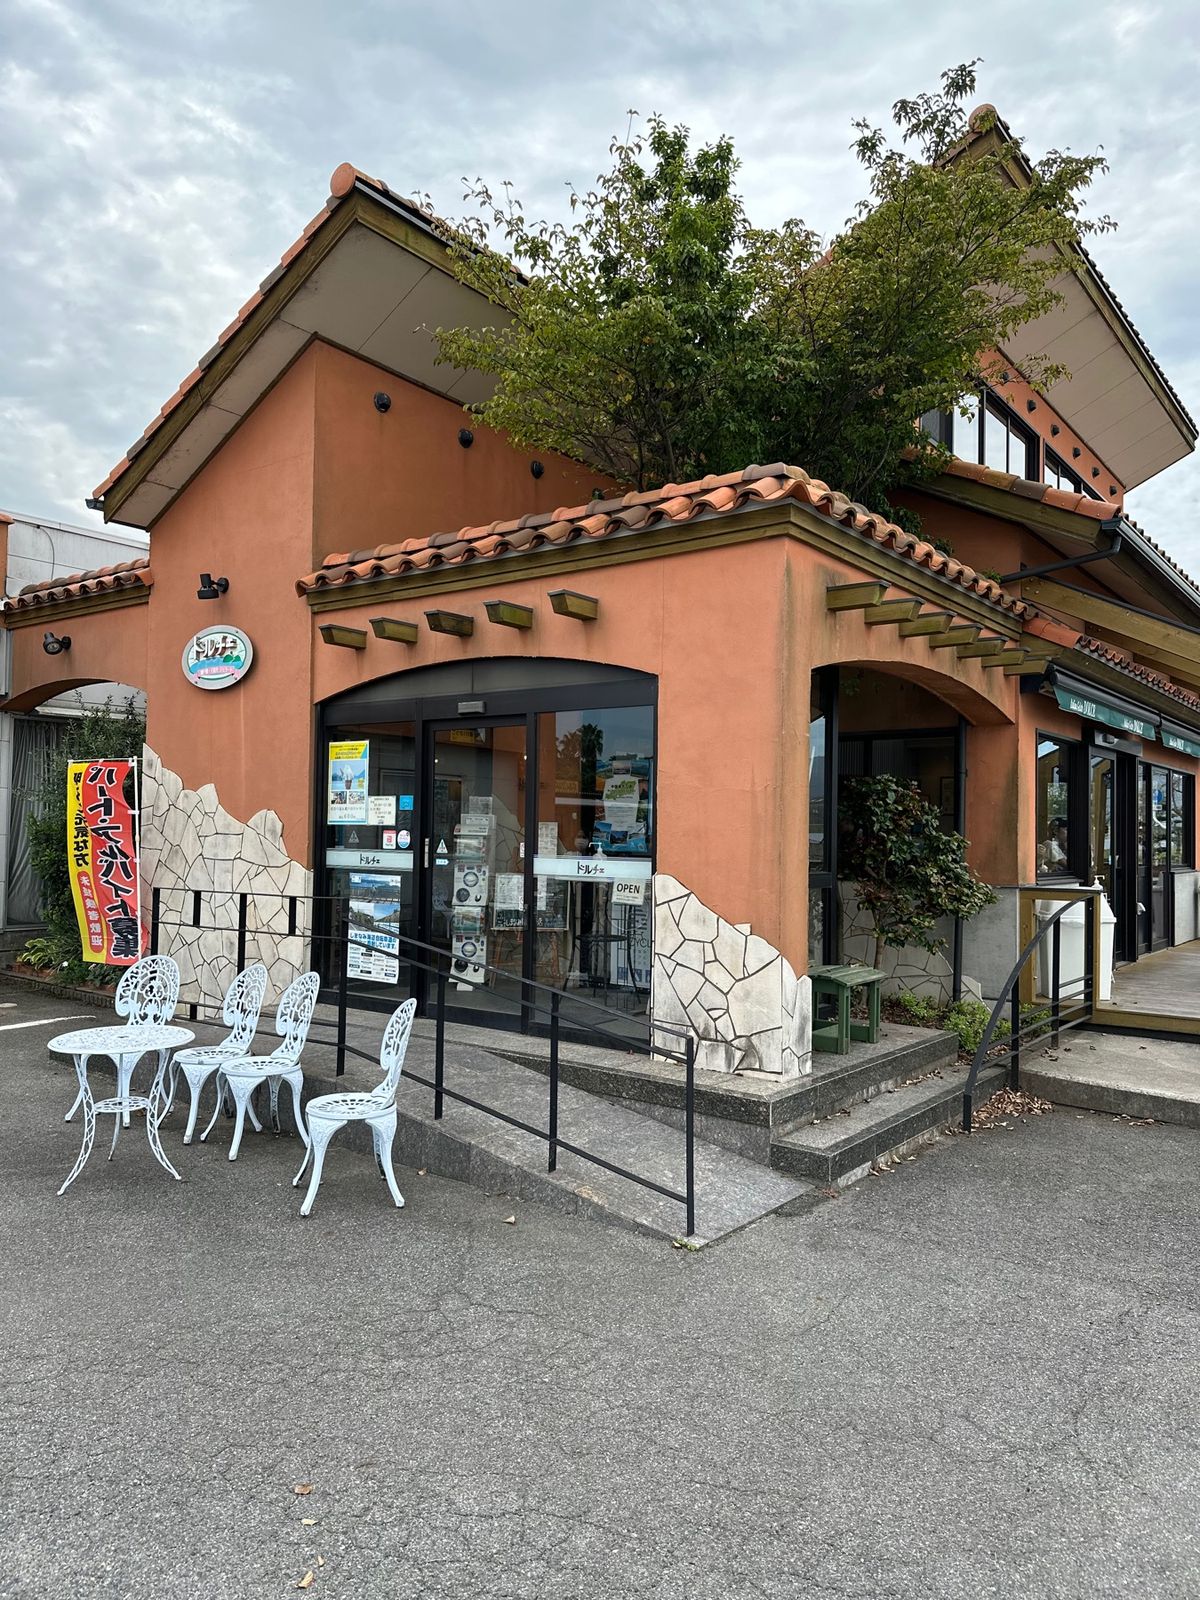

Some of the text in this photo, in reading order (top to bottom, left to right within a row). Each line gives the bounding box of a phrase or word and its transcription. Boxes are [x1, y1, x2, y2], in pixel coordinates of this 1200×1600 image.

[193, 635, 238, 661] ドルチェ
[360, 853, 380, 865] ドルチェ
[577, 861, 605, 875] ドルチェ
[616, 883, 640, 894] OPEN
